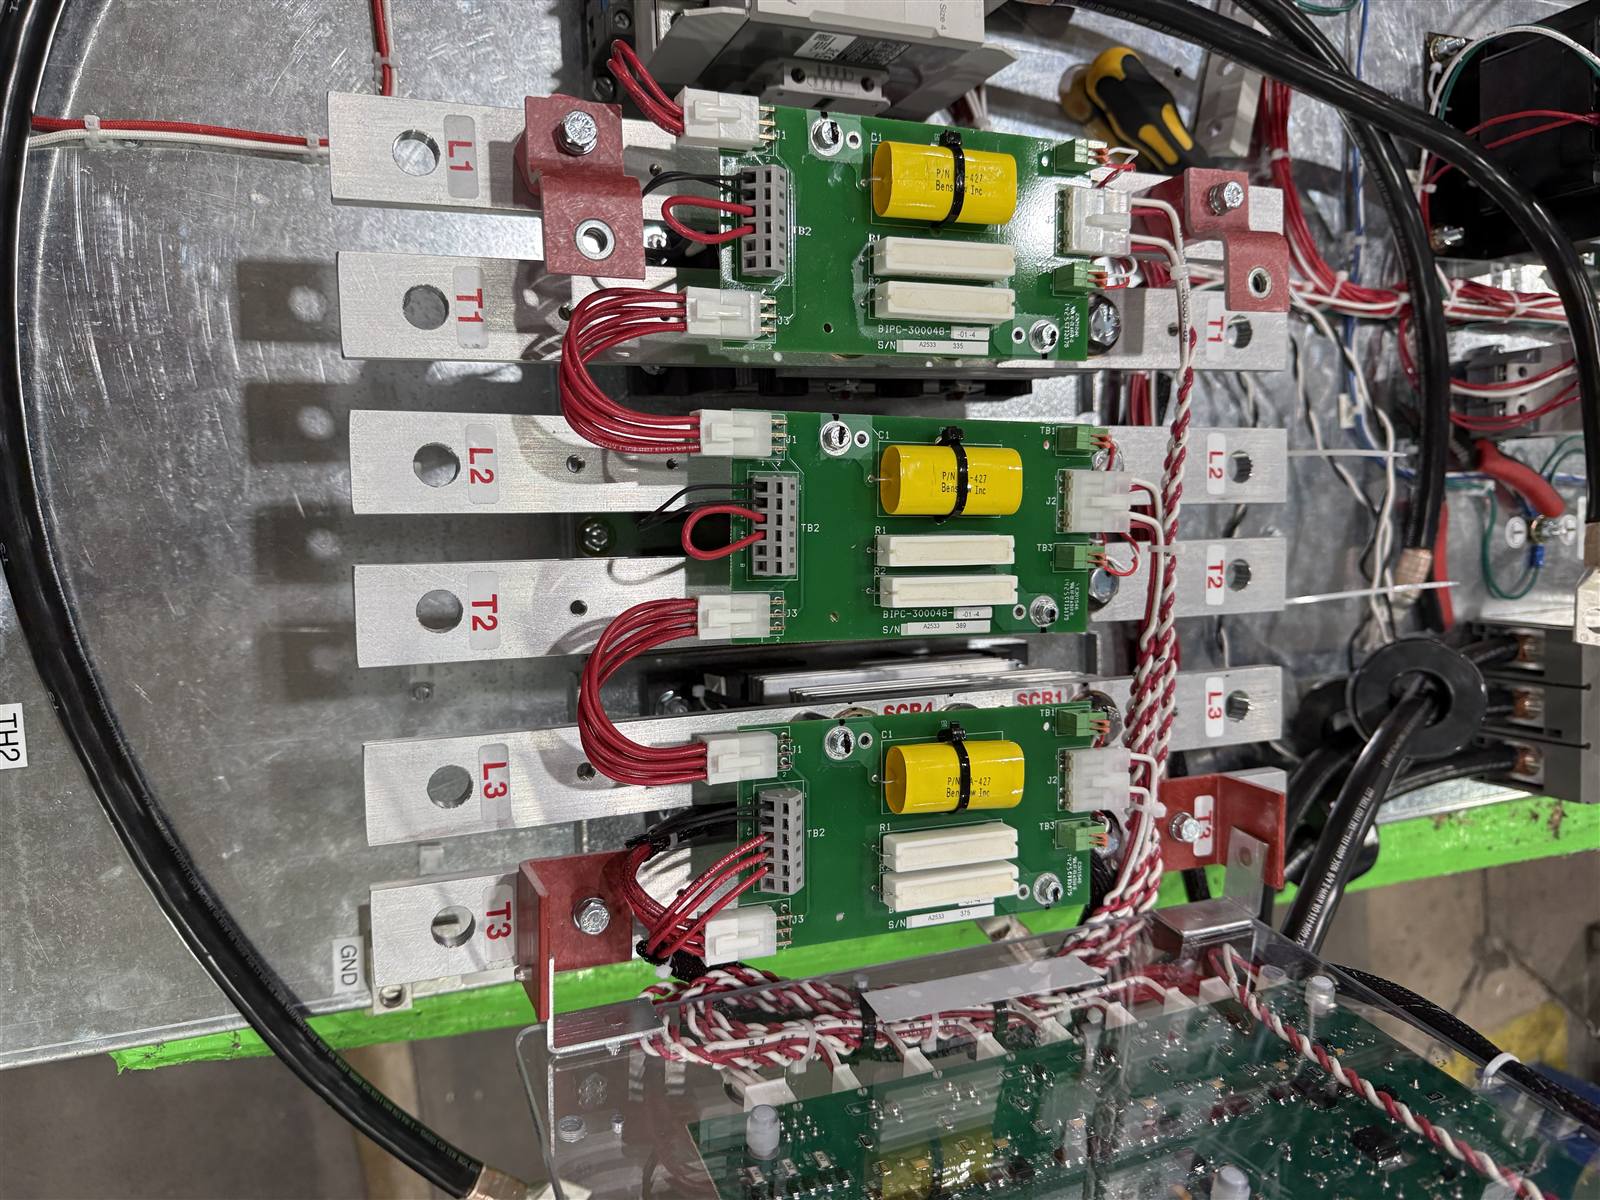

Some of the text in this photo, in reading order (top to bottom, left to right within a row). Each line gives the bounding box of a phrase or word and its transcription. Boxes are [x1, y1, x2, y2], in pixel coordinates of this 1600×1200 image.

[871, 132, 882, 141] C1
[447, 140, 473, 172] L1
[937, 168, 950, 179] P/N
[971, 185, 982, 195] Inc
[869, 233, 880, 242] R1
[456, 288, 484, 322] T1
[1208, 316, 1224, 342] T1
[878, 341, 896, 350] S/N
[878, 430, 890, 440] C1
[1040, 426, 1056, 436] TB1
[786, 435, 797, 444] J1
[469, 447, 494, 484] L2
[1208, 450, 1224, 480] L2
[943, 472, 955, 480] P/N
[976, 486, 986, 494] Inc
[1046, 497, 1056, 505] J2
[801, 523, 820, 533] TB2
[875, 526, 886, 535] R1
[1036, 544, 1053, 552] TB3
[874, 567, 886, 576] R2
[1207, 560, 1224, 589] T2
[471, 594, 498, 631] T2
[786, 609, 798, 618] J3
[882, 625, 900, 634] S/N
[1017, 692, 1062, 706] SCR1
[1207, 691, 1223, 720] L3
[1040, 709, 1055, 717] TB1
[0, 713, 20, 762] TH2
[881, 731, 893, 739] C1
[483, 762, 508, 799] L3
[948, 777, 991, 786] P/N A-427
[1047, 776, 1058, 785] J2
[946, 788, 990, 798] Benw Inc
[880, 823, 890, 832] R1
[1040, 822, 1055, 831] TB3
[1199, 810, 1213, 841] T3
[807, 829, 825, 838] TB2
[486, 901, 512, 940] T3
[792, 915, 804, 924] J3
[888, 919, 906, 929] S/N
[340, 944, 358, 986] GND
